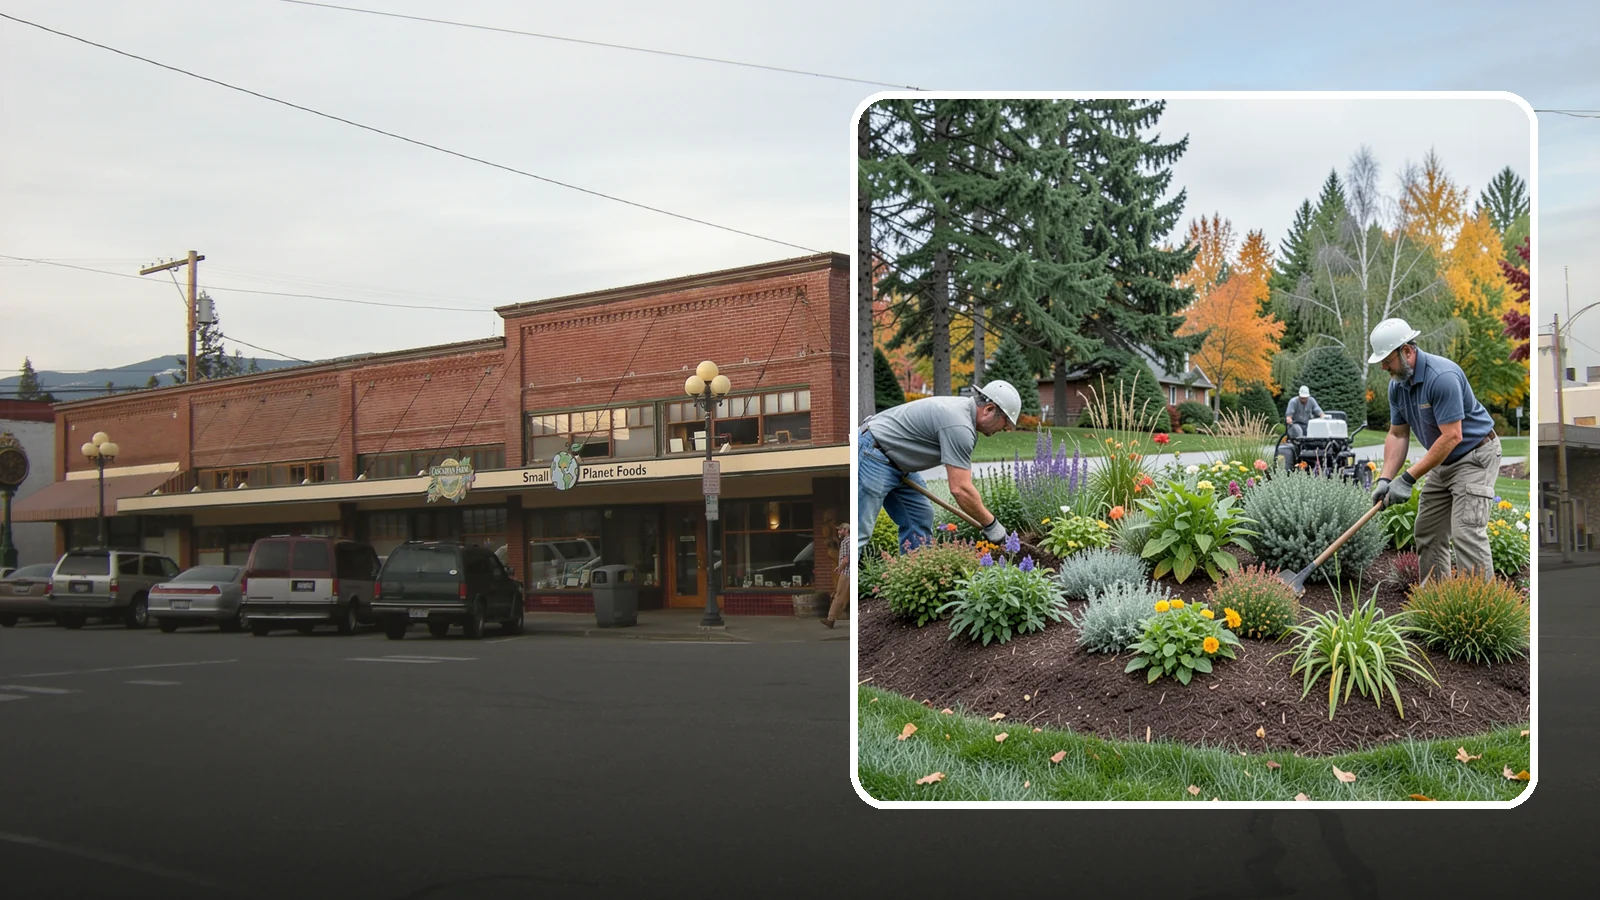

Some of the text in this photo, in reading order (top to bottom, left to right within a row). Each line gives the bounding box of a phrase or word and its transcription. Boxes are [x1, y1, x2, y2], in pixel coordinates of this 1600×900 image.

[523, 464, 647, 483] Small Planet Foods
